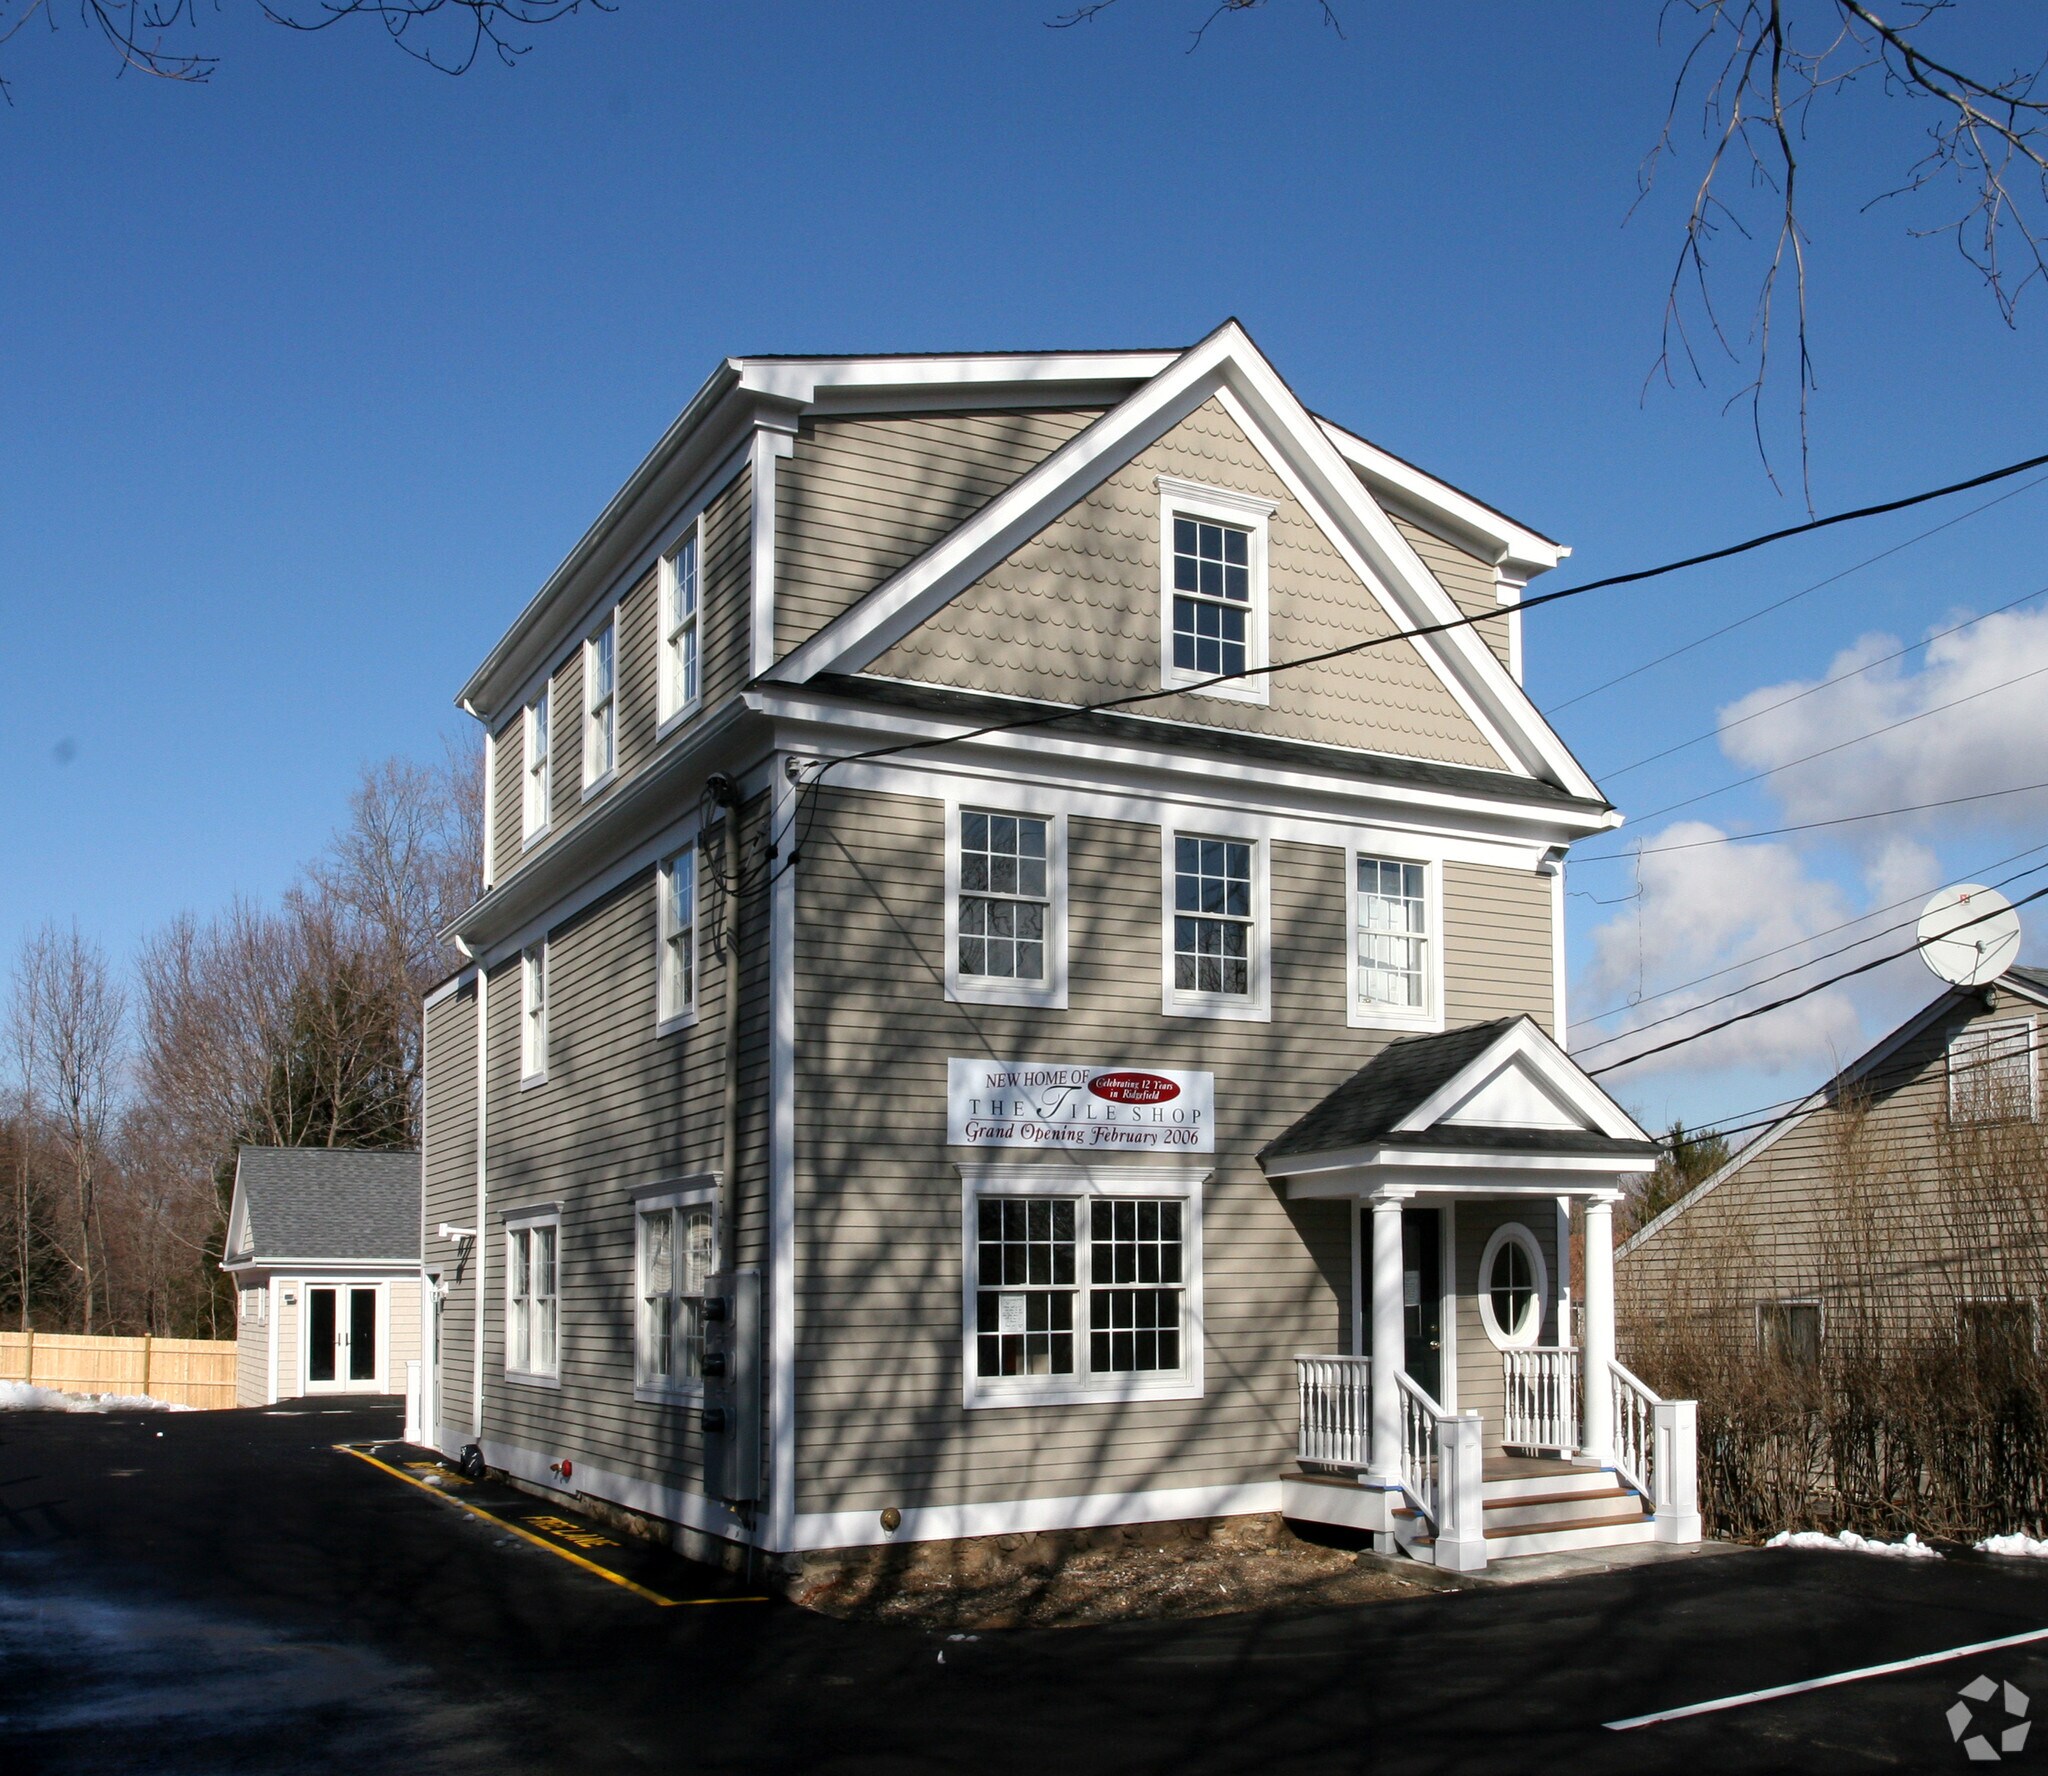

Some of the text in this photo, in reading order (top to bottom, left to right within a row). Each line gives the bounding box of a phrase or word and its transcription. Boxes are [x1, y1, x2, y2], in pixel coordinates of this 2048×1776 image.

[986, 1069, 1090, 1089] NEW HOME OF
[1095, 1078, 1174, 1091] Celebrating 12 Years
[969, 1085, 1202, 1124] THE TILE SHOP
[1110, 1088, 1160, 1101] in Ridgefield
[965, 1121, 1199, 1146] Grand Opening February 2006
